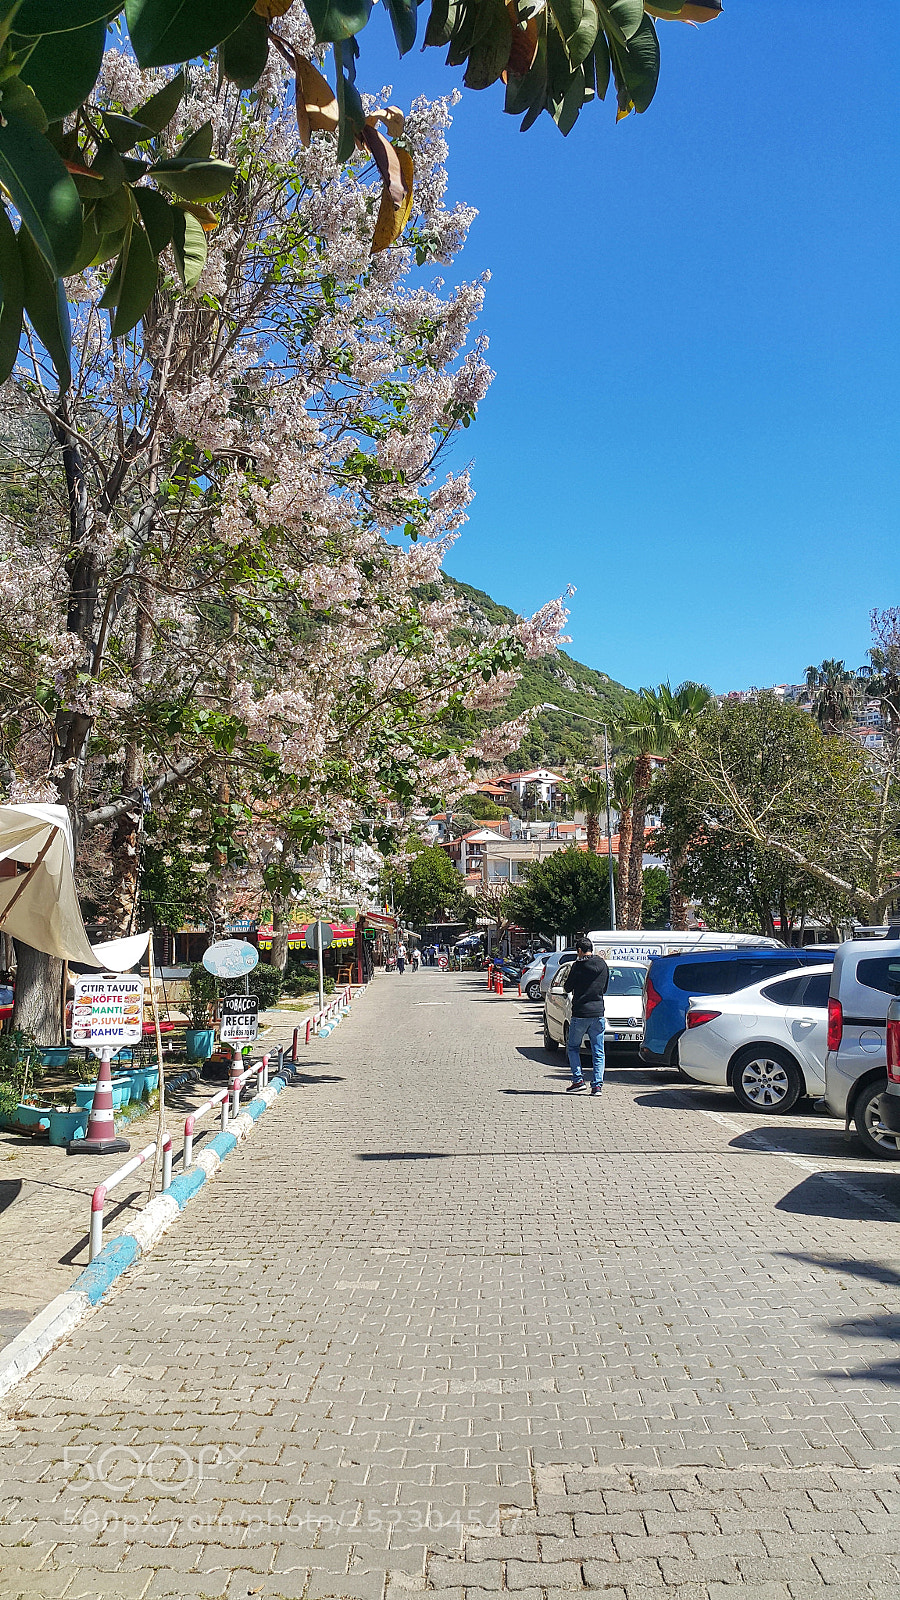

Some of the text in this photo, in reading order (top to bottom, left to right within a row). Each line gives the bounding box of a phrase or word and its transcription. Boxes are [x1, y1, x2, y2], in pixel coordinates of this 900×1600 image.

[612, 947, 658, 955] TALAYLAR
[81, 984, 138, 994] ÇITIR TAVUK
[92, 994, 123, 1003] KÖFTE
[226, 998, 256, 1012] TOBACCO
[91, 1006, 122, 1014] MANTI
[91, 1017, 124, 1025] P.SUYU
[225, 1016, 256, 1026] RECEP
[91, 1028, 124, 1036] KAHVE
